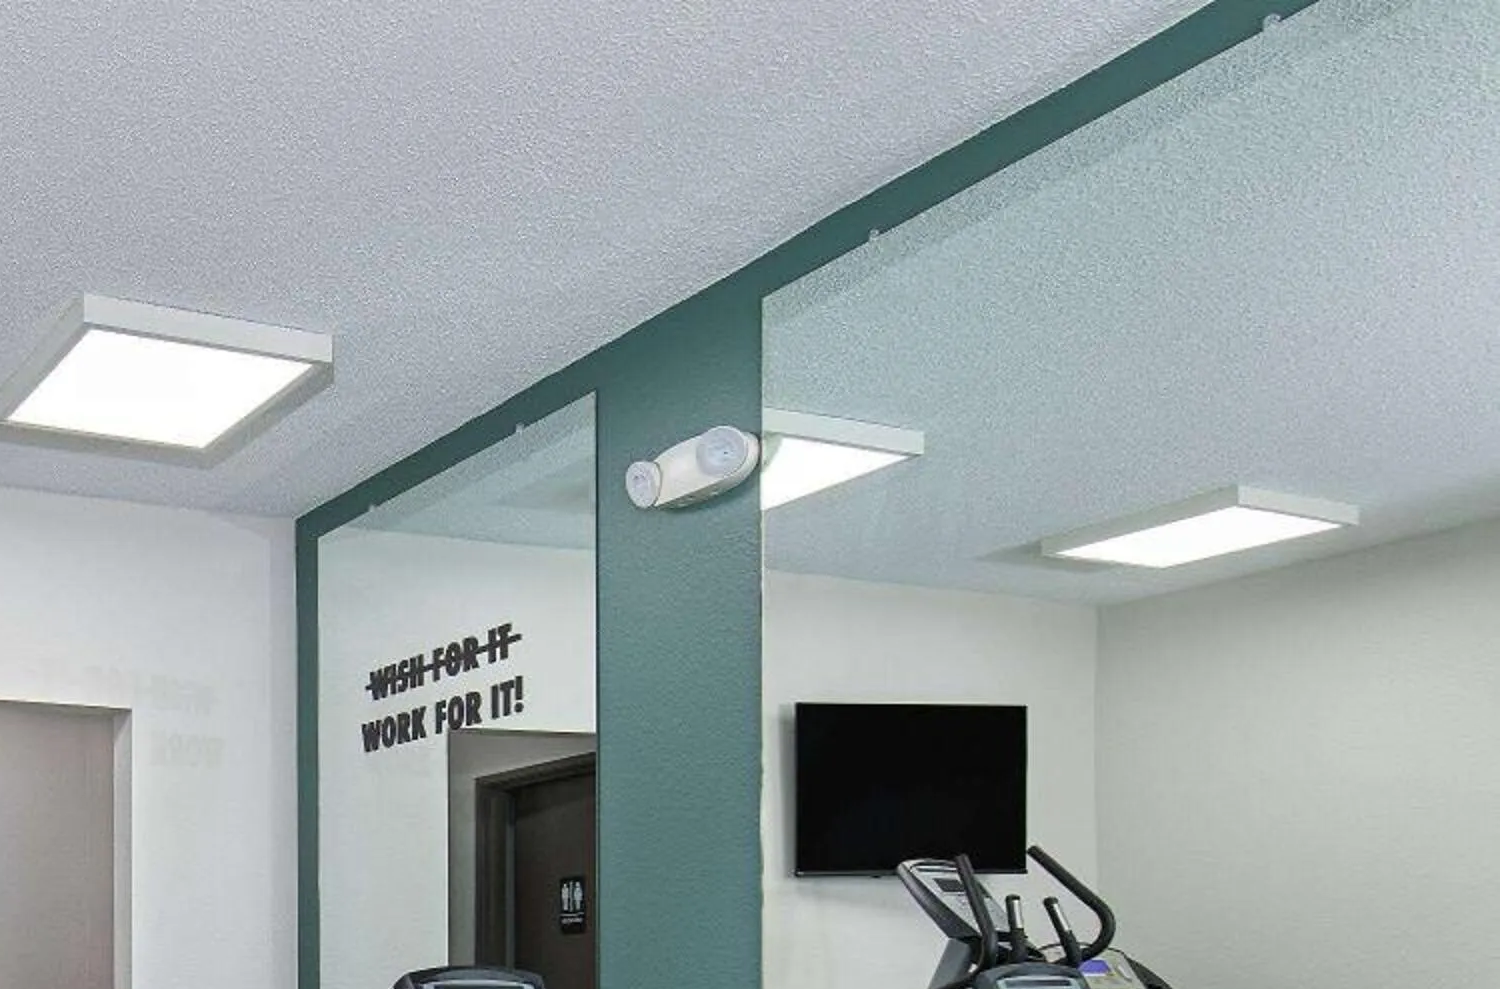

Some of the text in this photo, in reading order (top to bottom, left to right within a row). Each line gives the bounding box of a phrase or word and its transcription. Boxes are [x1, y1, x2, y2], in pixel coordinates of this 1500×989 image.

[368, 622, 513, 701] WISH FOR IT
[361, 675, 525, 753] WORK FOR IT!
